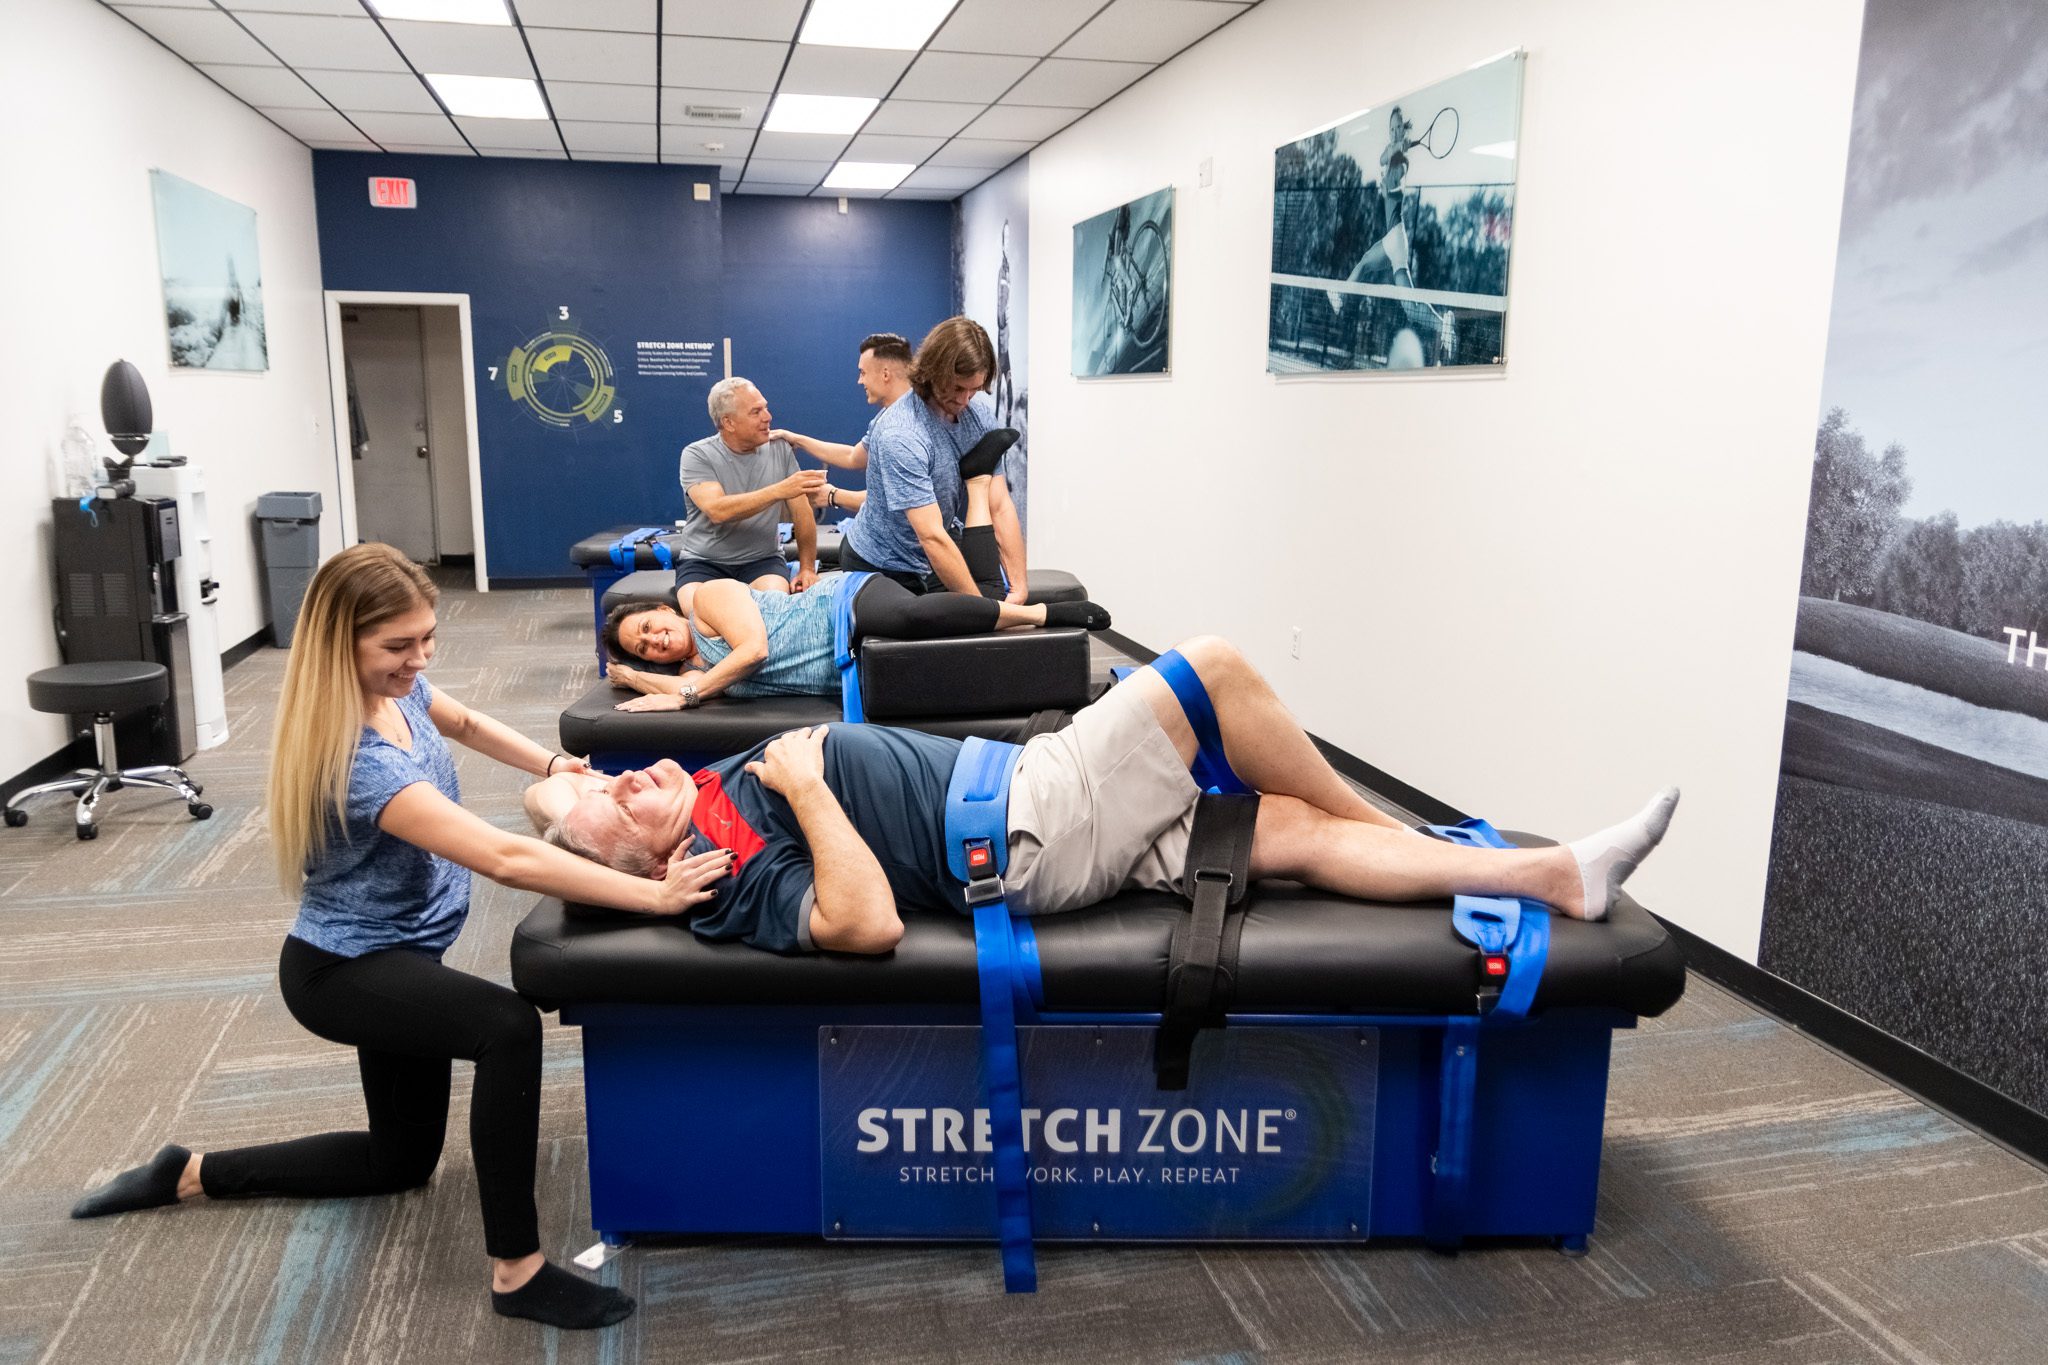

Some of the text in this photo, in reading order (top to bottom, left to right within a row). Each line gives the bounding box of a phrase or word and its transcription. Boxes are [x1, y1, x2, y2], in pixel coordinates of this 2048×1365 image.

[376, 178, 409, 205] EXIT
[559, 306, 569, 320] 3
[637, 341, 666, 350] STRETCH
[667, 342, 684, 350] ZONE
[488, 367, 498, 380] 7
[613, 410, 623, 423] 5
[1026, 1167, 1083, 1183] ORK.
[1093, 1168, 1150, 1183] PLAY.
[1161, 1168, 1240, 1183] REPEAT
